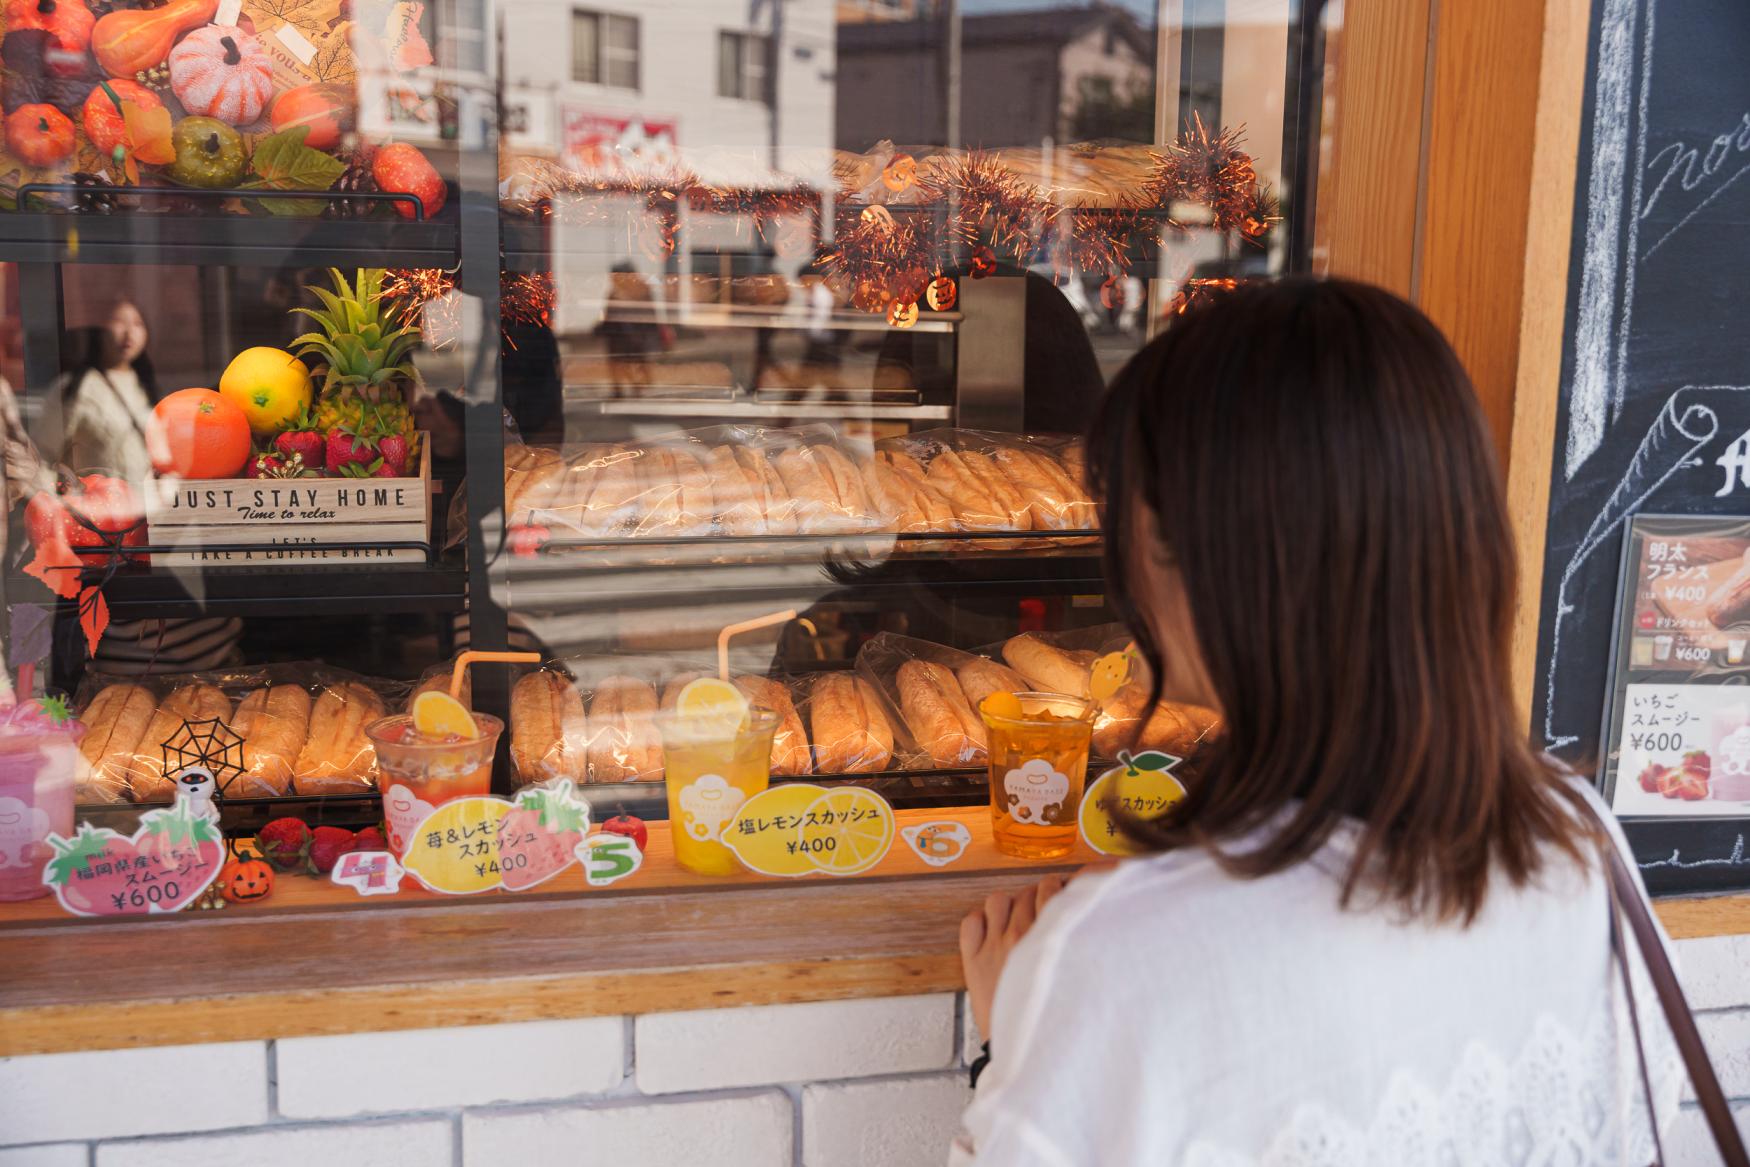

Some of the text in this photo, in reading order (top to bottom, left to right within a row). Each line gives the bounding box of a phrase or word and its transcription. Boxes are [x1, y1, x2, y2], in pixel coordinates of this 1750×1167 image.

[173, 488, 405, 509] JUST STAY HOME
[237, 506, 336, 520] Time to relax
[1649, 542, 1688, 561] 明太
[1646, 563, 1710, 580] フランス
[1664, 585, 1706, 602] ¥400
[1675, 647, 1712, 661] ¥600
[1633, 693, 1679, 709] いちご
[1631, 711, 1701, 726] スムージー
[1630, 732, 1683, 752] ¥600
[738, 807, 880, 836] 塩レモンスカッシュ
[459, 833, 538, 859] スカッシュ
[786, 836, 837, 855] ¥400
[125, 861, 209, 887] スムージー
[474, 853, 527, 877] ¥400
[111, 881, 180, 910] ¥600
